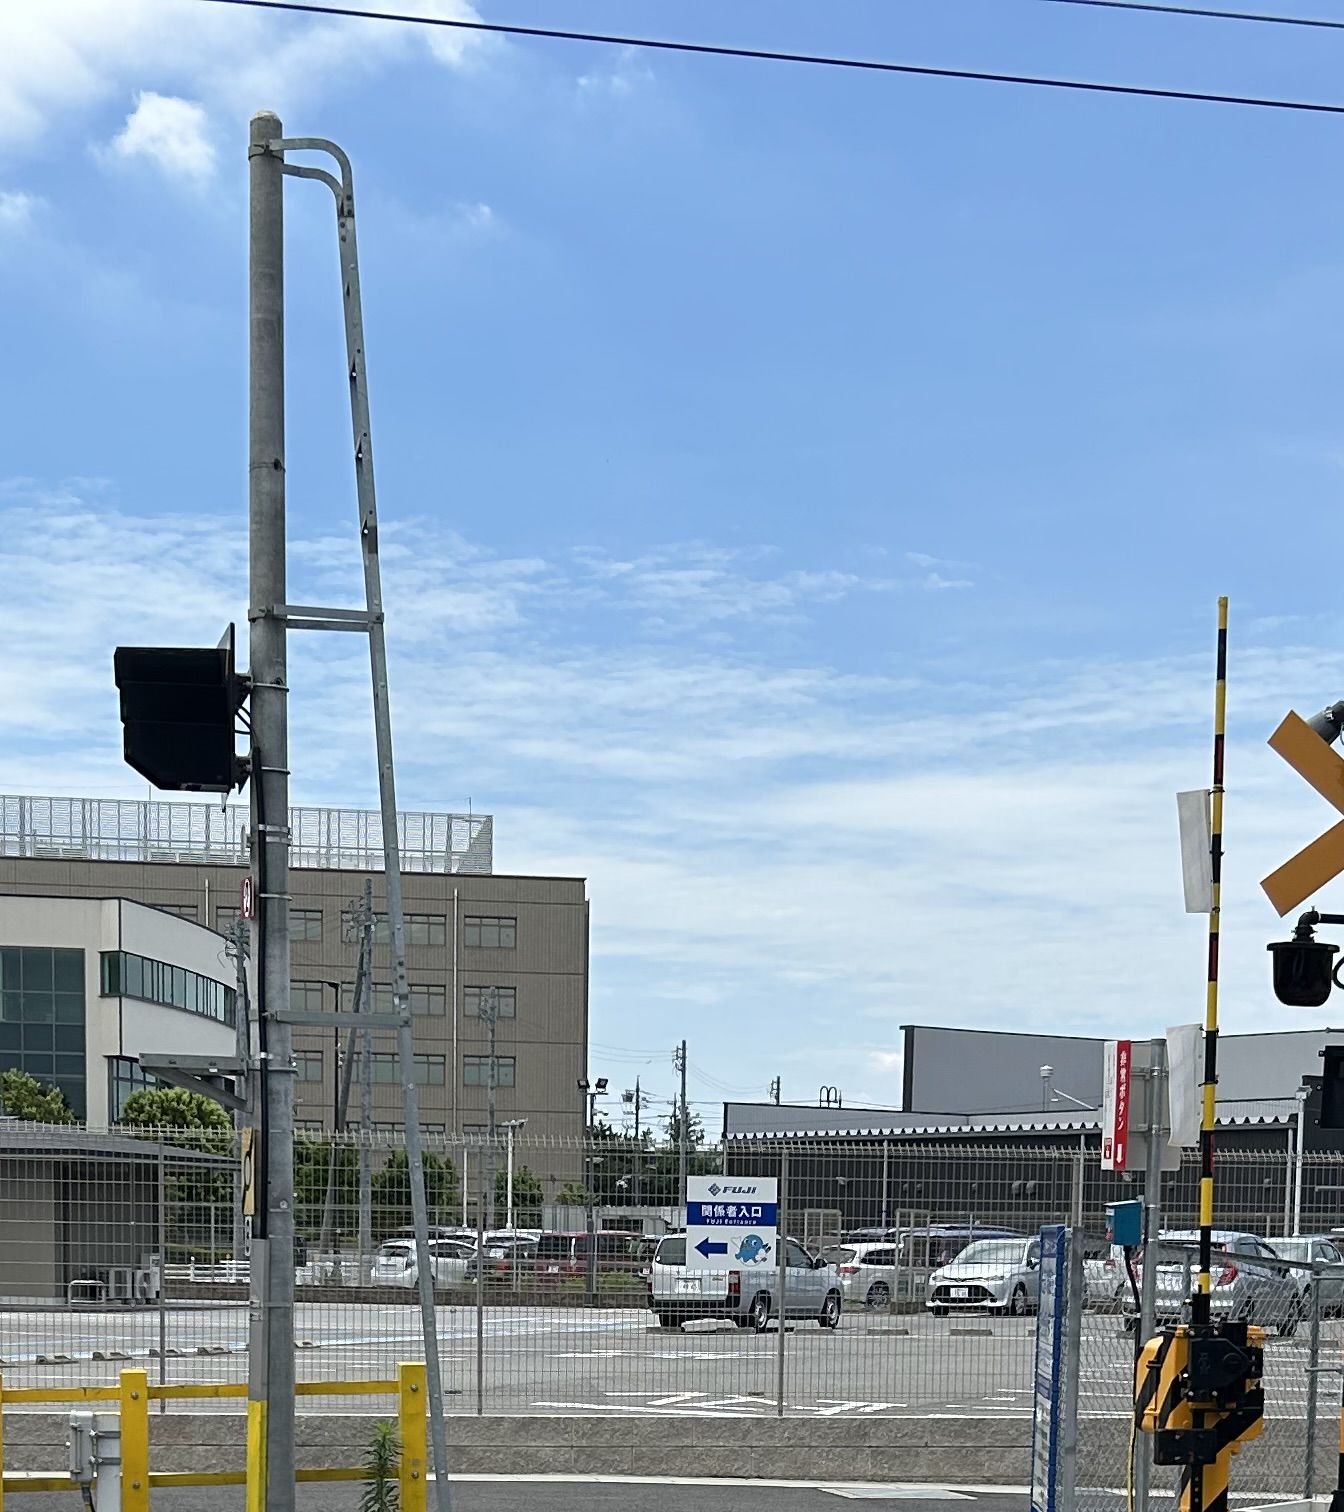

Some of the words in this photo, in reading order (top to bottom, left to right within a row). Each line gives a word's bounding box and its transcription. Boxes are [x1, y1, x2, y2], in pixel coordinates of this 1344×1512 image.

[702, 1205, 761, 1217] 関係者入口
